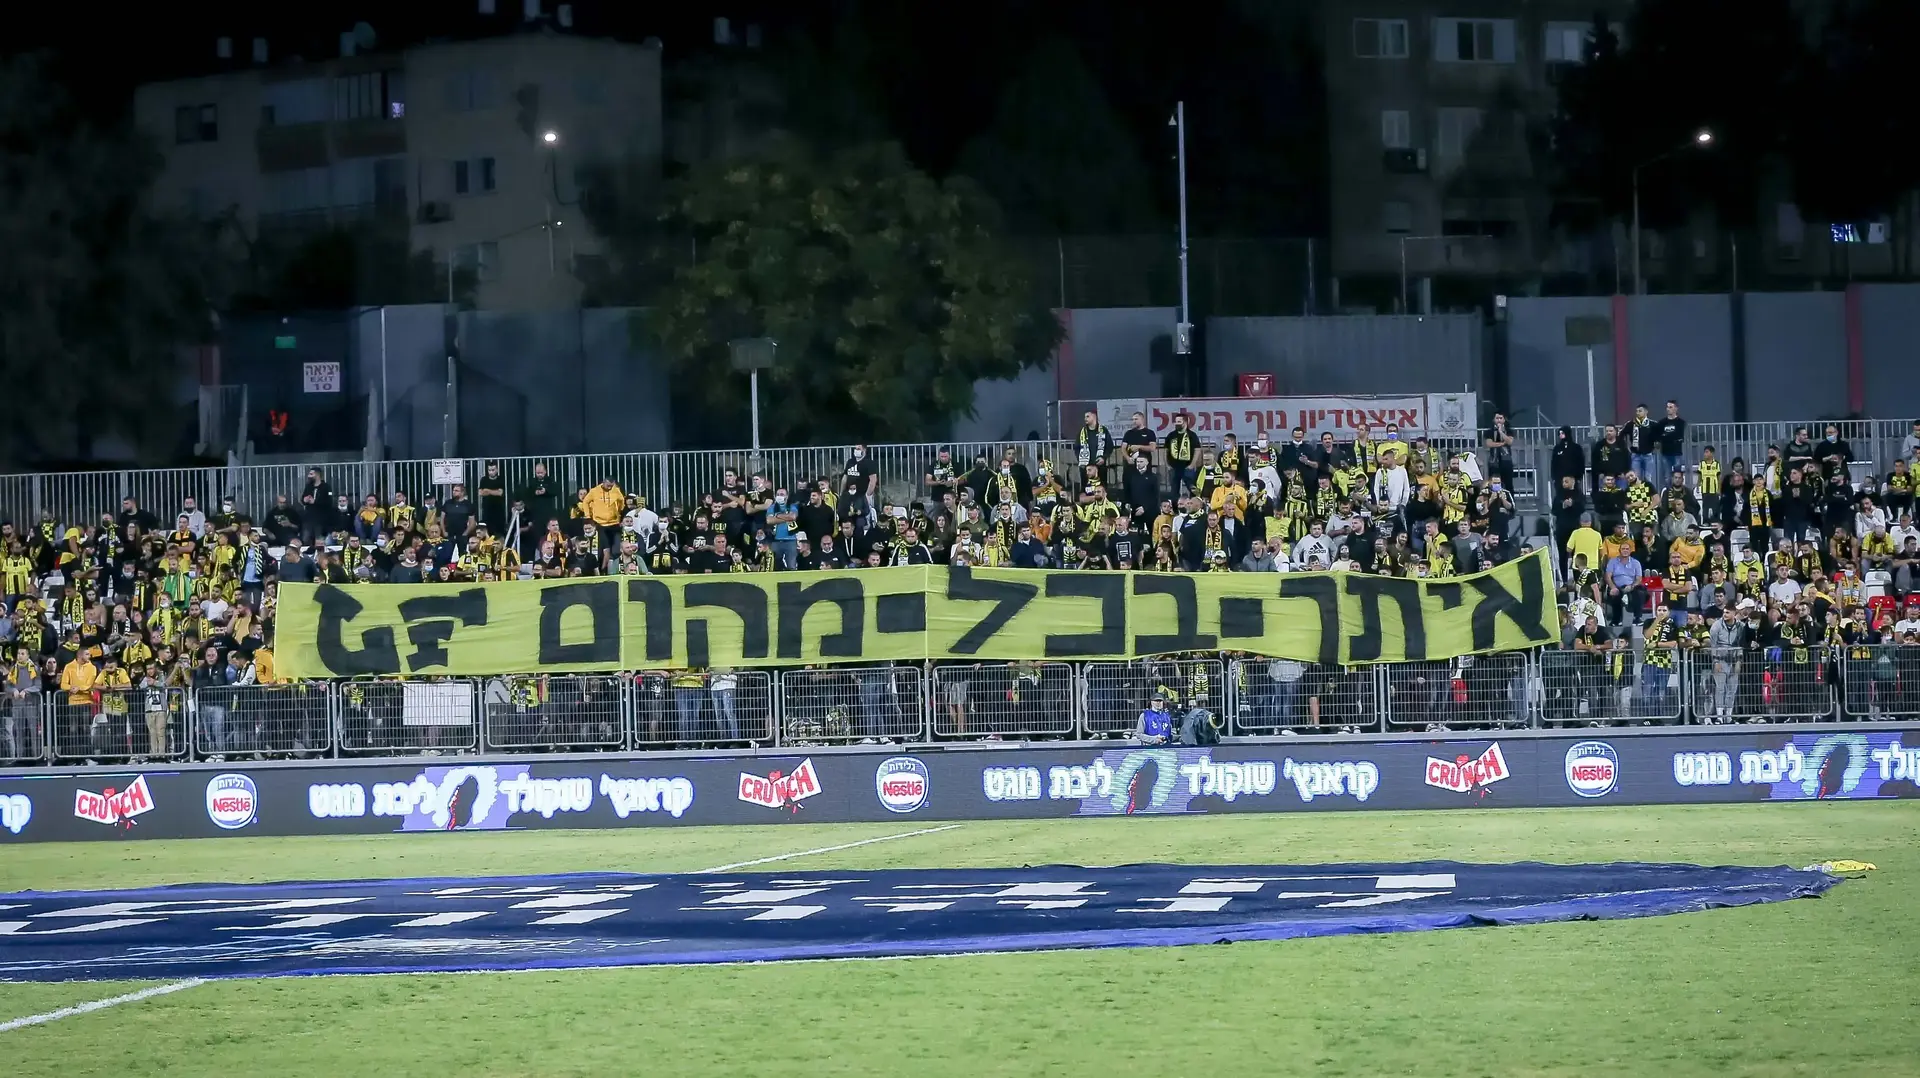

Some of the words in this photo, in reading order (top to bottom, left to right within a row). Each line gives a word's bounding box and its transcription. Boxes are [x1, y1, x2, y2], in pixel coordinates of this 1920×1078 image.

[305, 364, 339, 376] יציאה
[313, 383, 333, 391] 10
[1244, 409, 1288, 431] נוף
[1299, 408, 1418, 431] איצטדיון
[888, 760, 916, 772] גלידות
[1577, 745, 1605, 756] גלידות
[1739, 742, 1804, 783] ליבת
[216, 777, 245, 789] גלידות
[741, 764, 814, 803] CRUNCH
[984, 766, 1041, 800] נוגט
[1049, 757, 1113, 799] ליבת
[1179, 756, 1275, 801] שוקולד
[1428, 749, 1502, 788] CRUNCH
[1674, 753, 1732, 785] נוגט
[77, 782, 147, 819] CRUNCH
[309, 783, 366, 817] נוגט
[372, 773, 437, 816] ליבת
[499, 772, 593, 818] שוקולד
